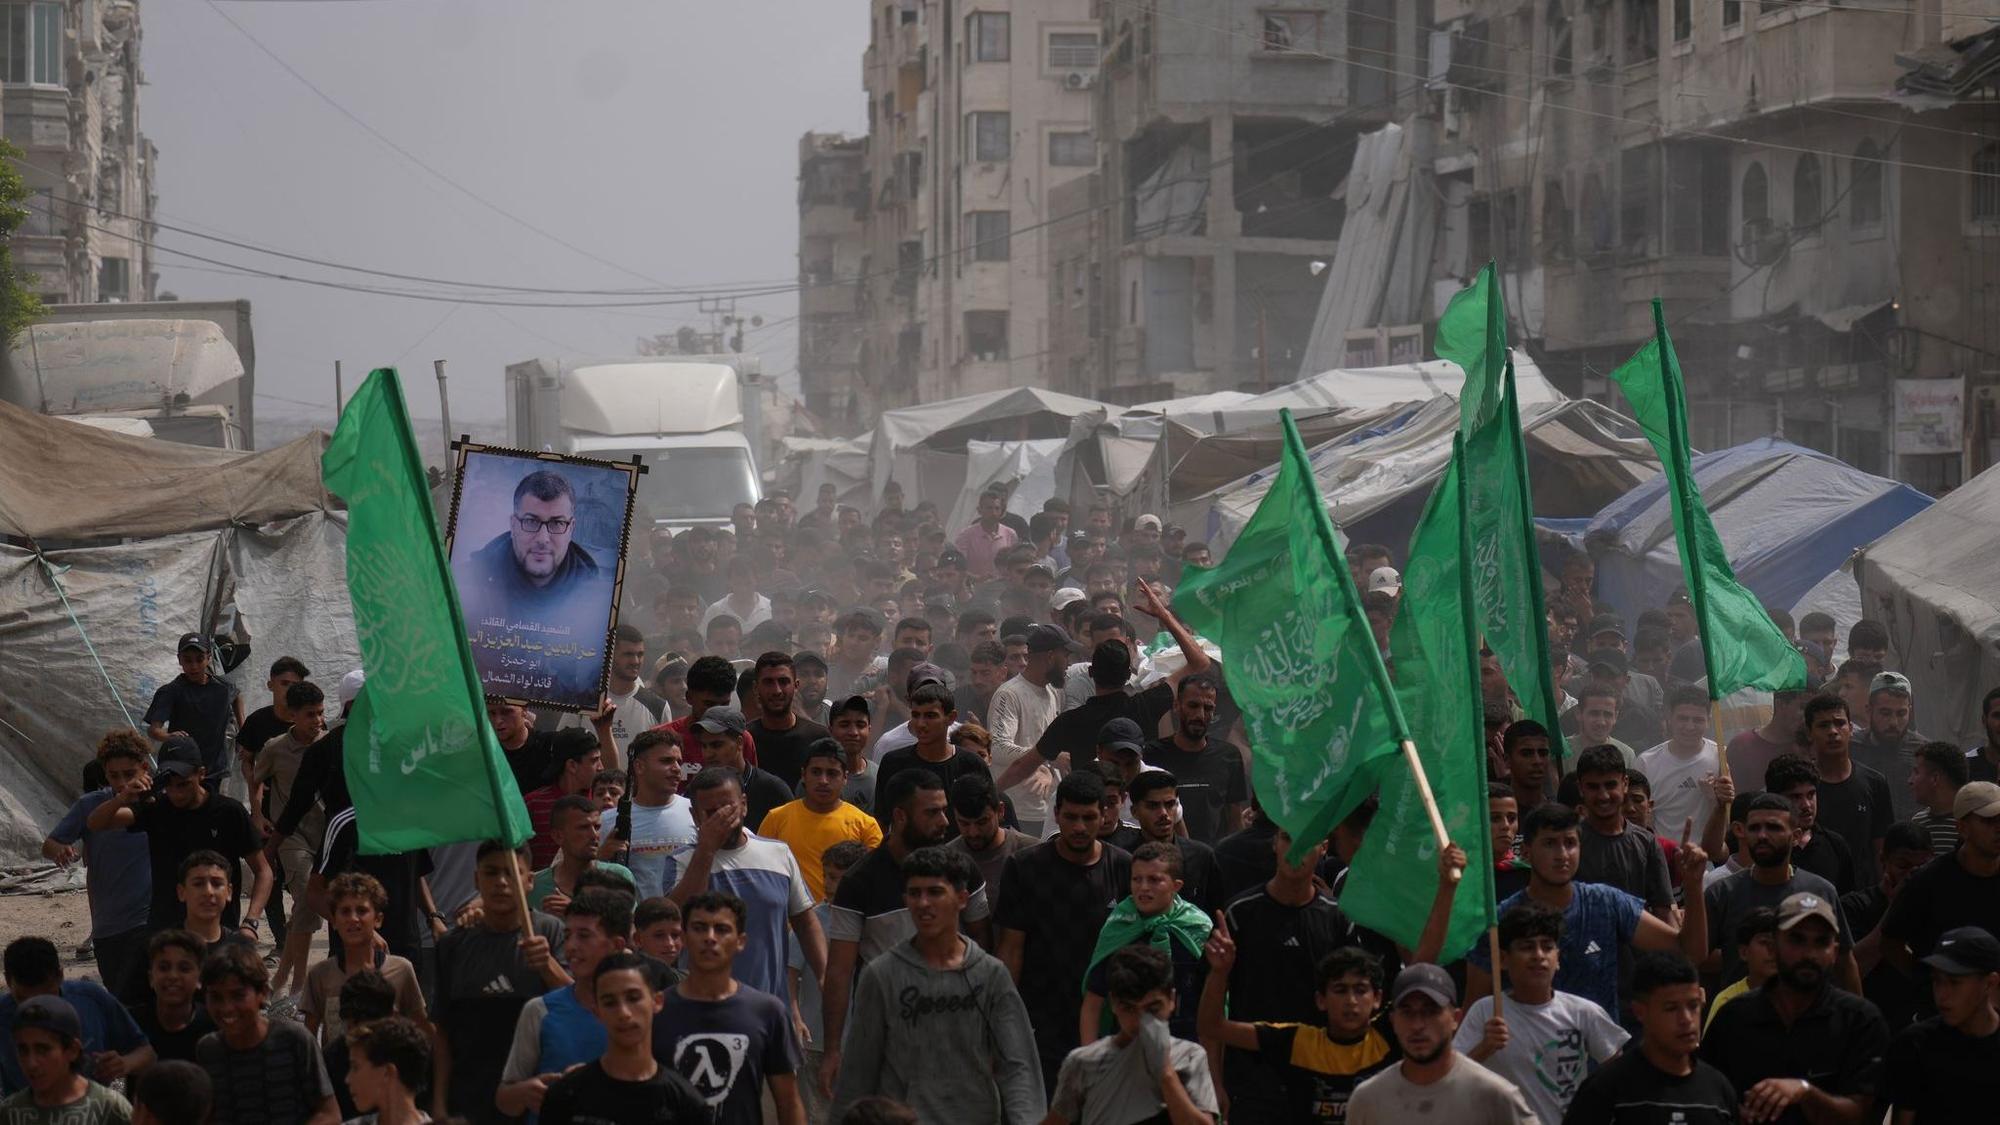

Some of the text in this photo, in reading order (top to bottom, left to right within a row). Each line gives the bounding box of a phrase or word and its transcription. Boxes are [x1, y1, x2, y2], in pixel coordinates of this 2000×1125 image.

[506, 620, 540, 634] القسامي
[482, 633, 520, 650] العزيز
[521, 639, 543, 653] عبد
[543, 643, 577, 657] الدين
[576, 647, 597, 660] عز
[500, 653, 527, 667] حمزة
[481, 671, 552, 689] قائد لواء الشمال
[899, 983, 985, 1028] Speed
[732, 1037, 743, 1051] 3
